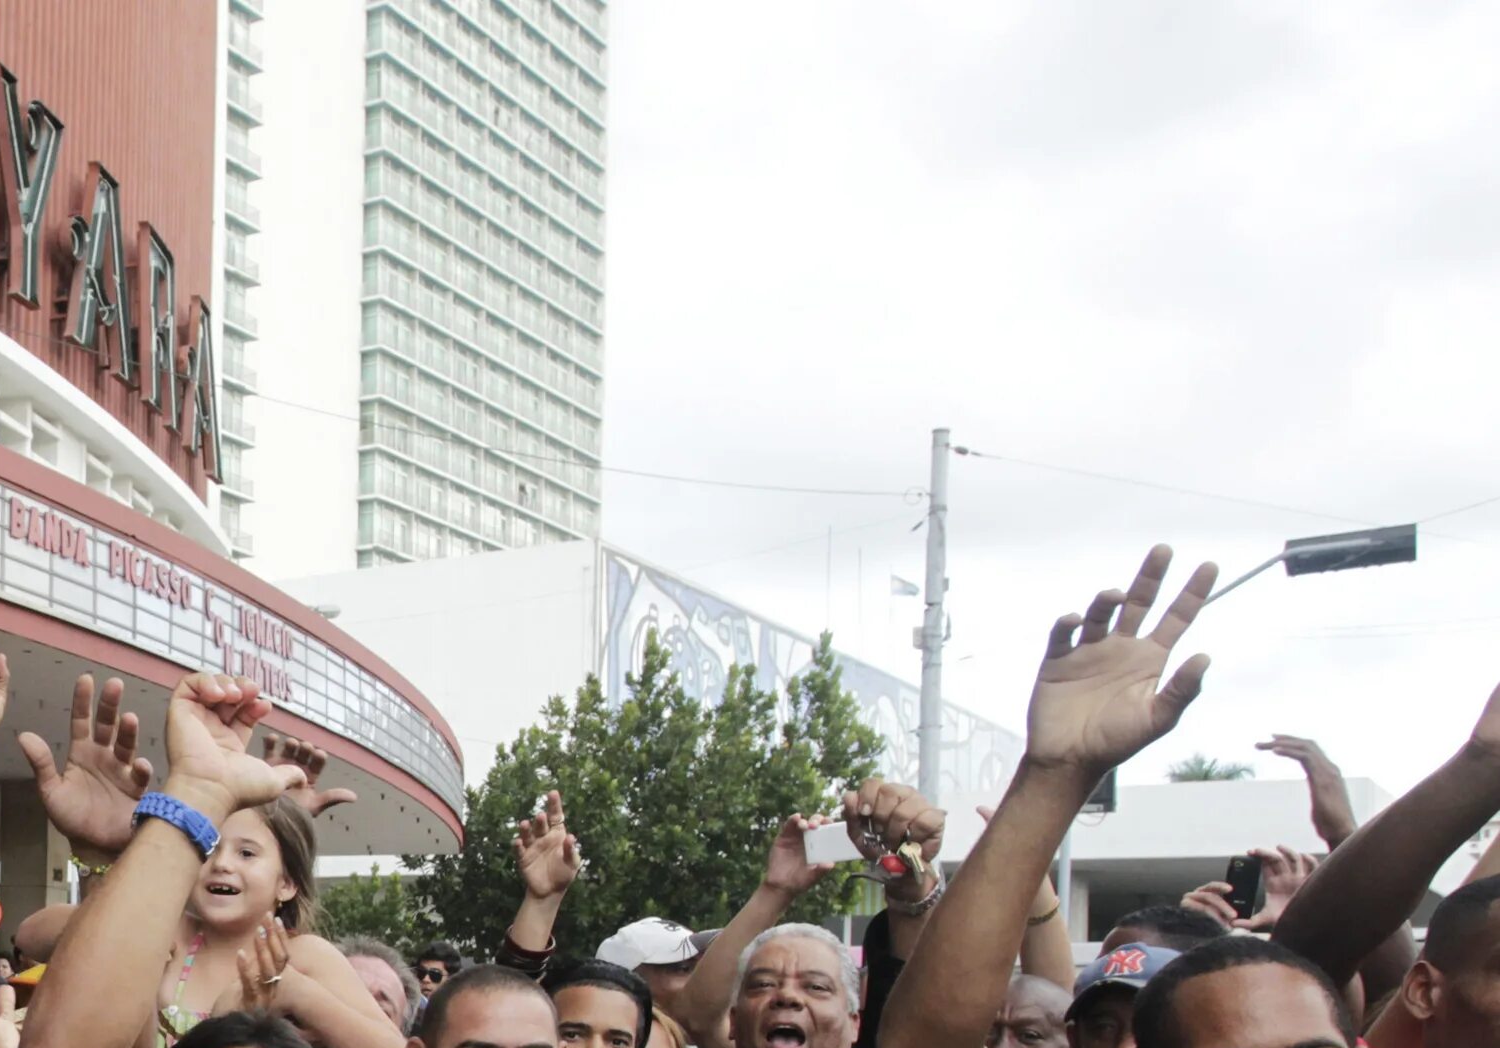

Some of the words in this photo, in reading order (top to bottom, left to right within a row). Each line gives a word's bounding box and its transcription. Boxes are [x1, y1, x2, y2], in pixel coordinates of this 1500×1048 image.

[9, 496, 90, 568] BANDA
[108, 540, 193, 611] PICASSO
[238, 605, 293, 660] IGNACIO
[240, 651, 293, 702] MATEOS
